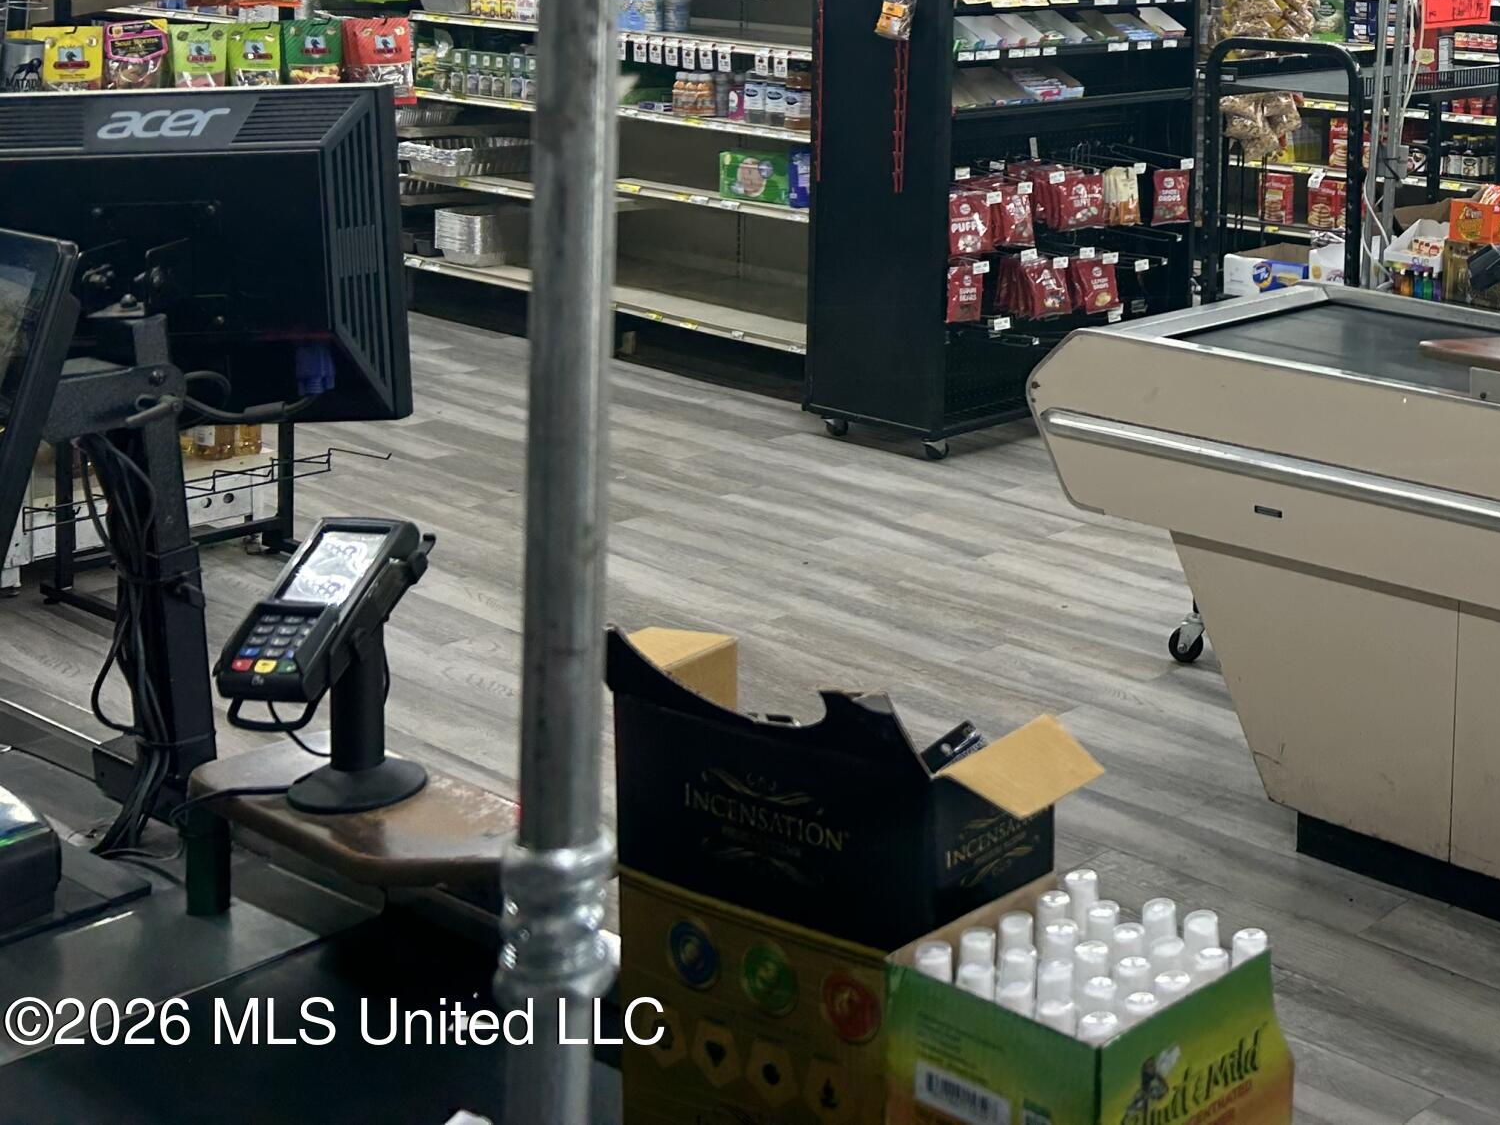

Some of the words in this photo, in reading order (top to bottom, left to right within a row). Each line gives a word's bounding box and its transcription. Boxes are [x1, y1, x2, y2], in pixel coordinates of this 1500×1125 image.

[97, 108, 231, 139] acer
[951, 220, 986, 234] PUFF
[684, 782, 844, 852] INCENSATION
